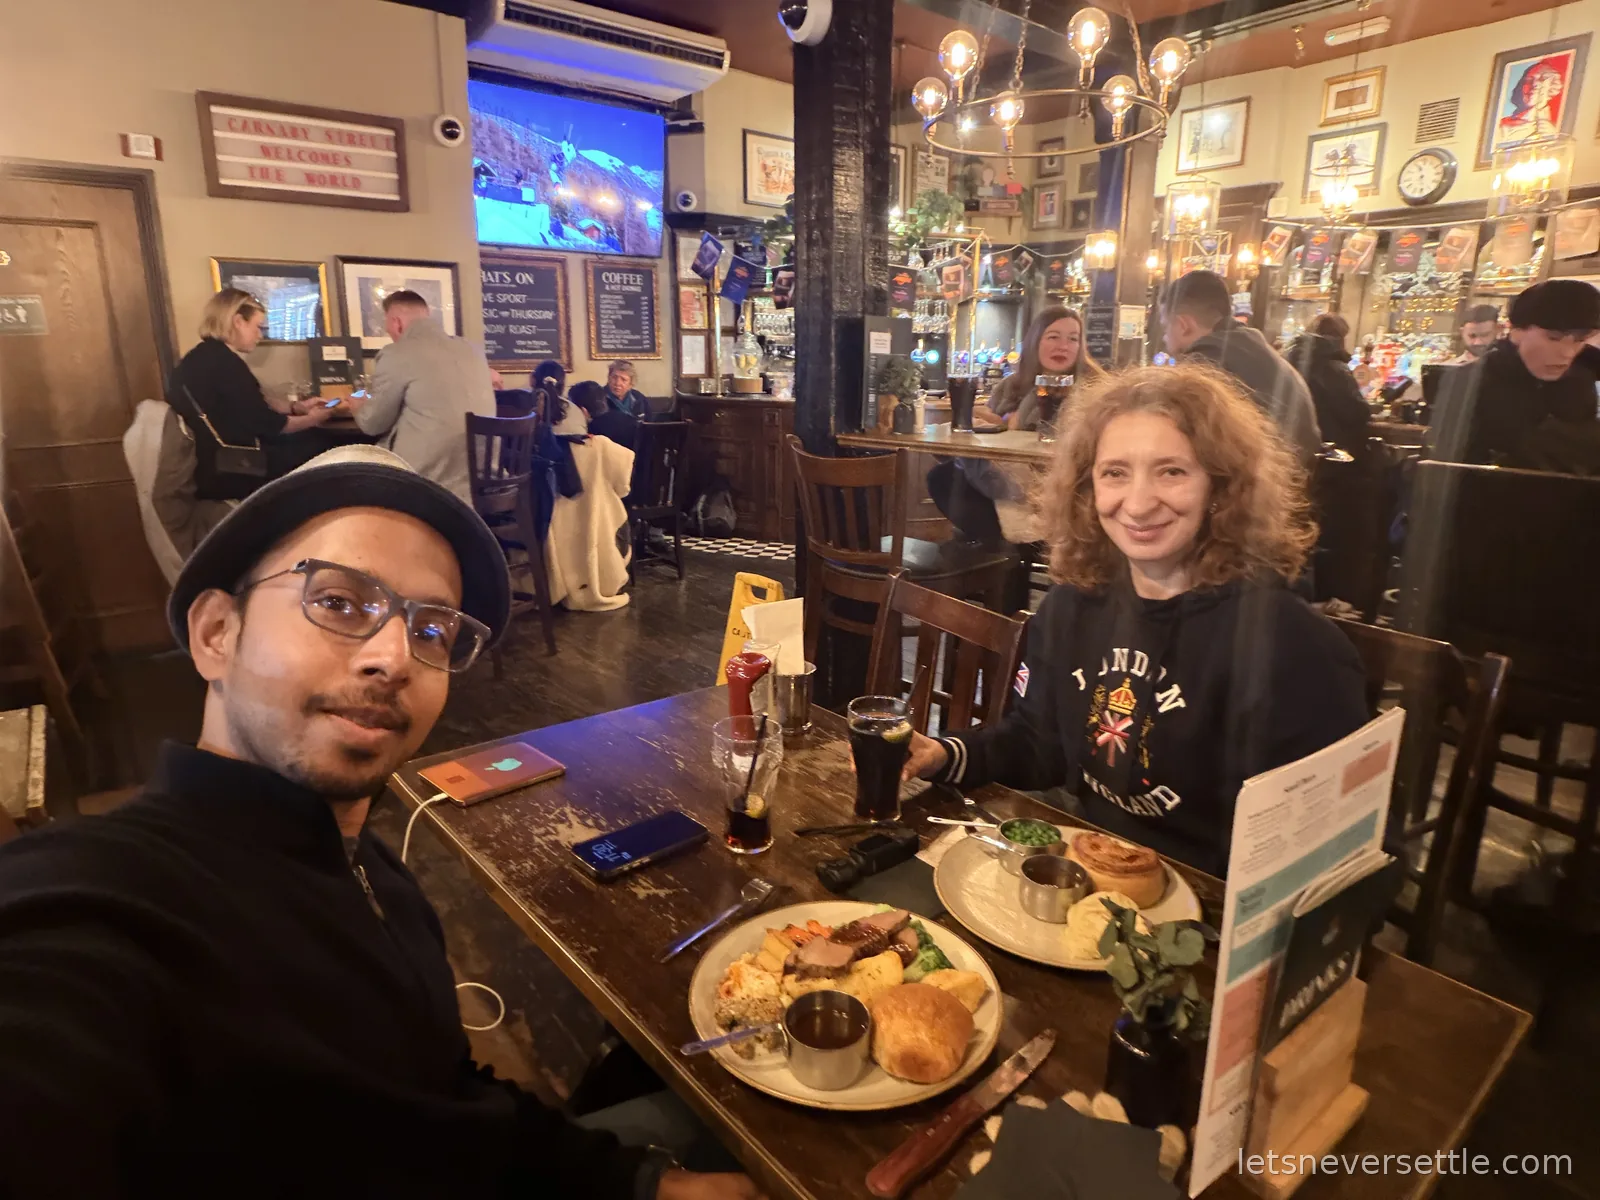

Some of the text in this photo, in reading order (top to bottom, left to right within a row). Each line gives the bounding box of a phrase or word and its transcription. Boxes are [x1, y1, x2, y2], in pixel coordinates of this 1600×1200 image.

[228, 118, 392, 149] CARNABY STREET
[260, 145, 353, 167] WELCOMES
[248, 166, 362, 189] THE WORLD
[481, 270, 535, 285] HAT'S ON
[601, 271, 645, 286] COFFEE
[496, 293, 528, 304] SPORT
